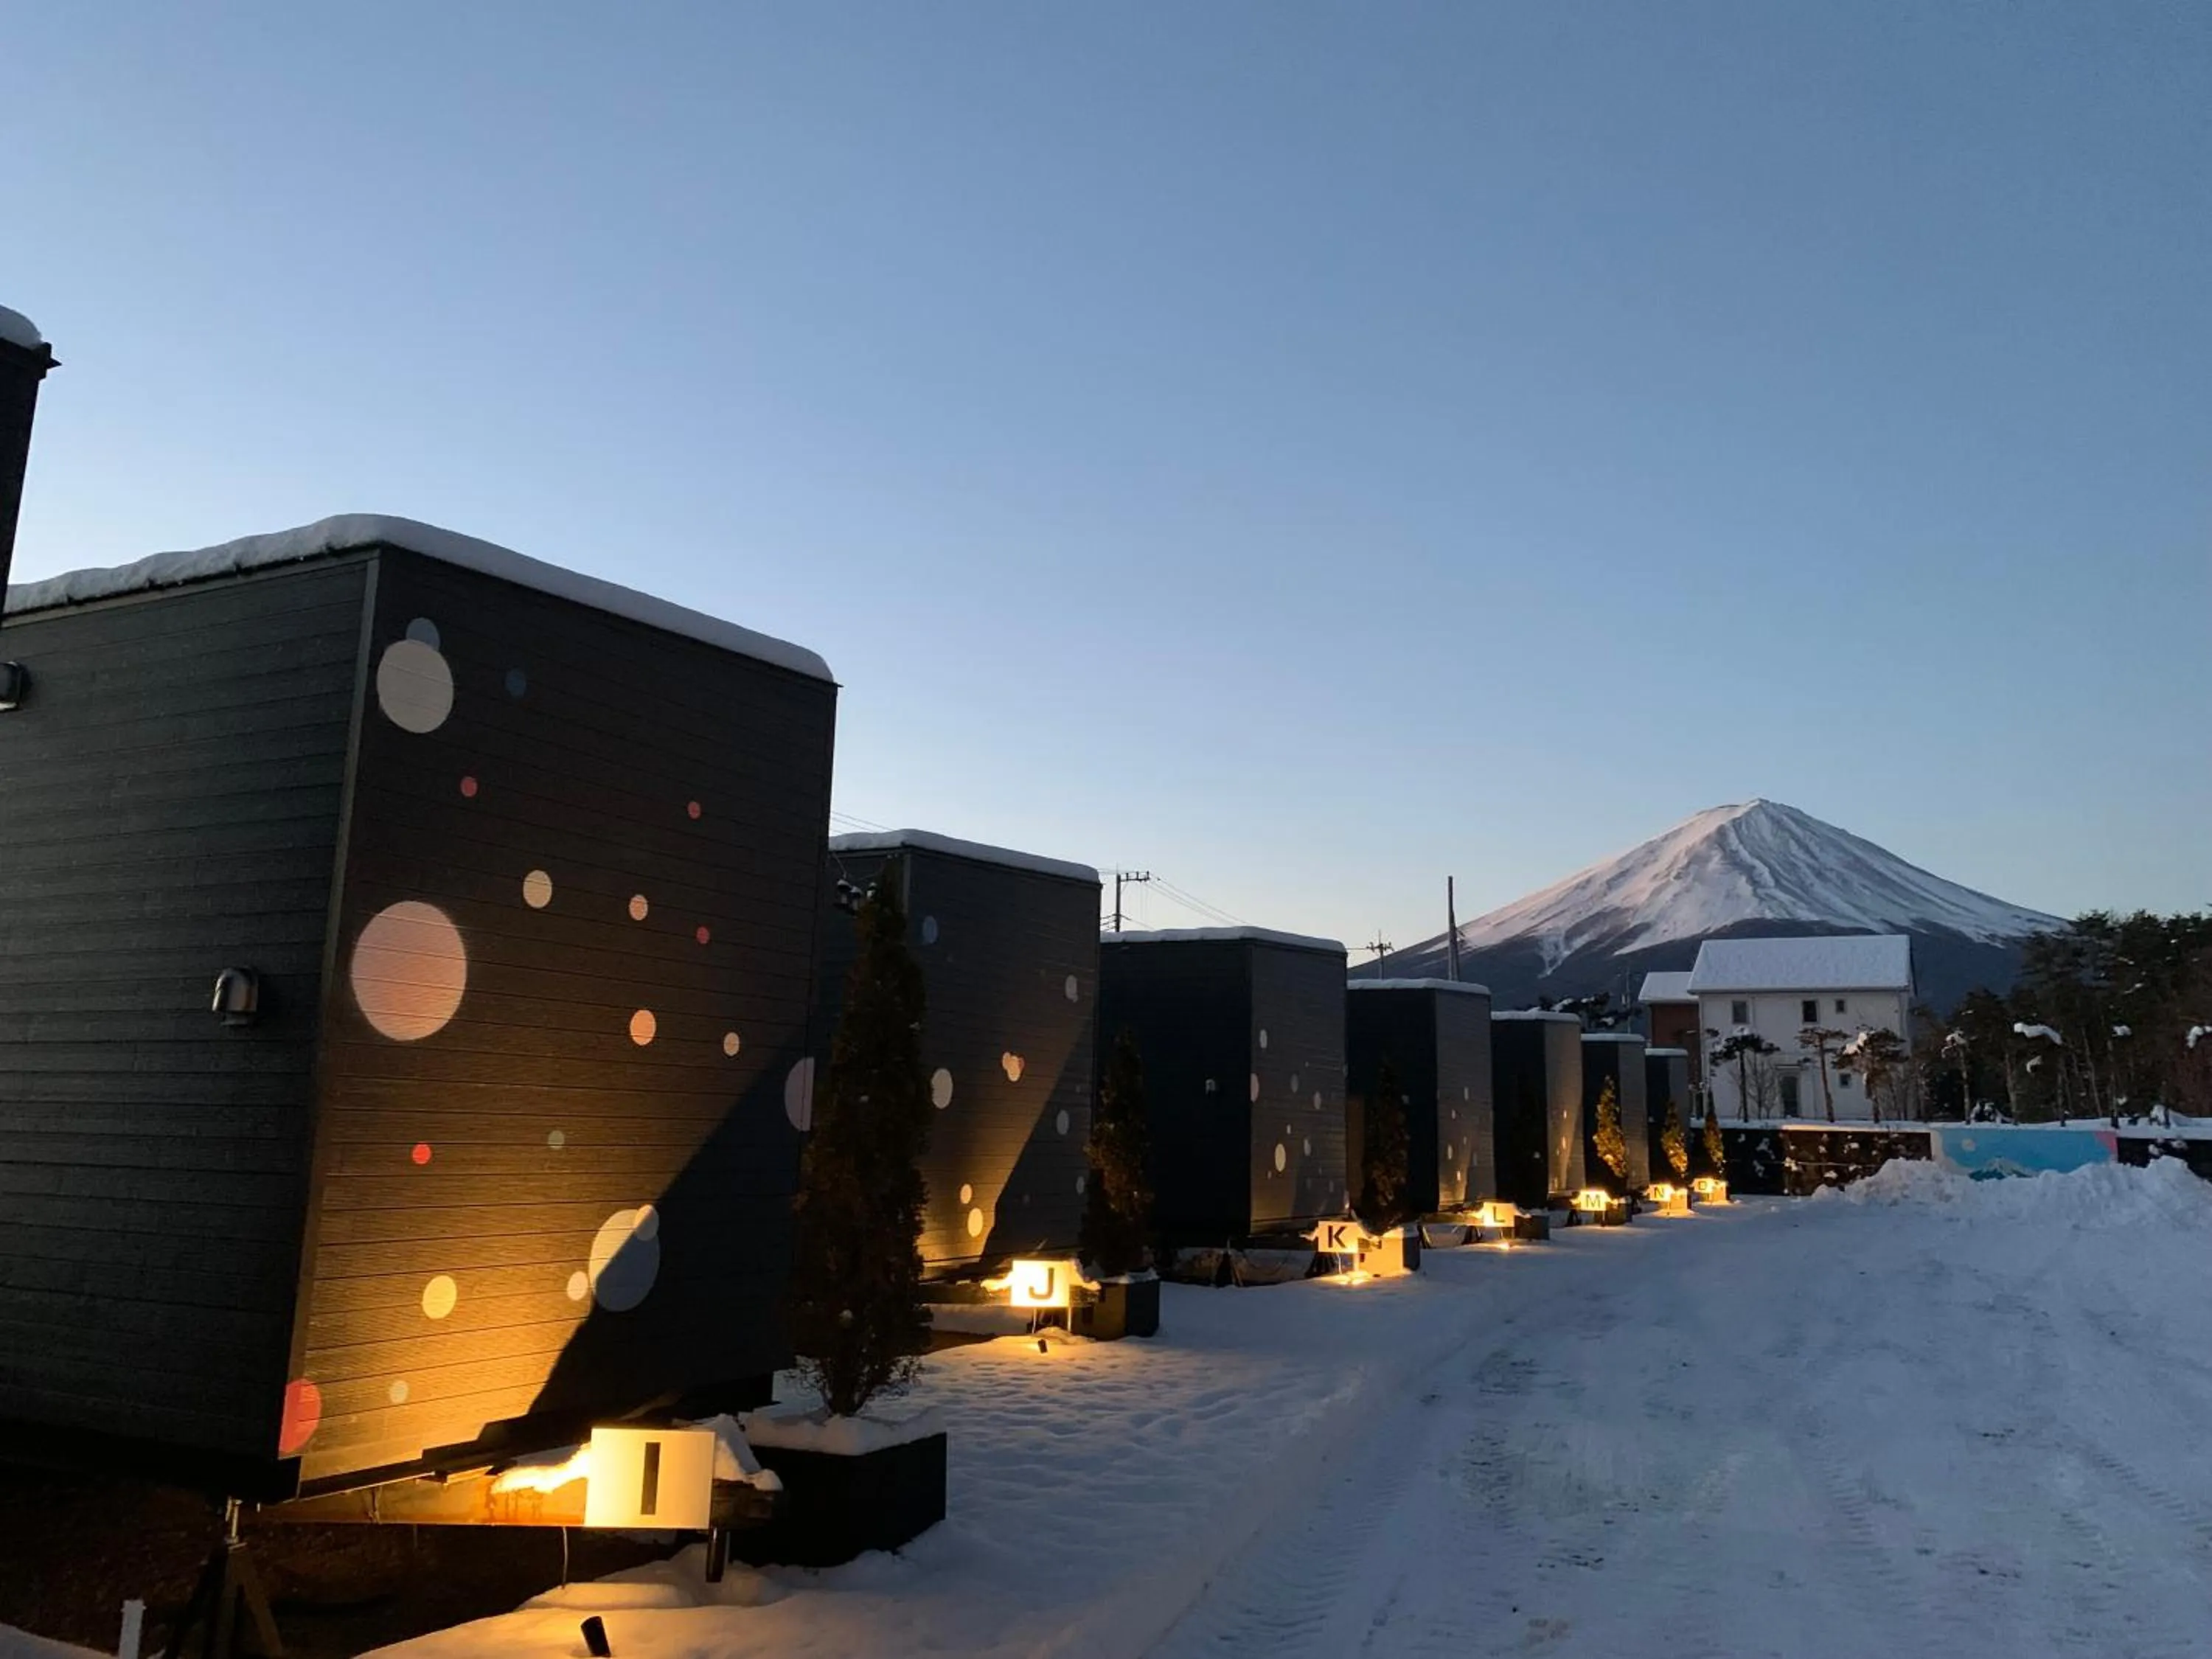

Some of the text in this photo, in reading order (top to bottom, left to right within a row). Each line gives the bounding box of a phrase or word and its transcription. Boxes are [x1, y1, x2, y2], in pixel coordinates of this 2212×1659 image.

[1586, 1194, 1601, 1208] M
[1654, 1187, 1664, 1198] N
[1492, 1206, 1506, 1222] L
[1328, 1225, 1347, 1248] K
[1029, 1267, 1054, 1300] J
[640, 1441, 661, 1515] I
